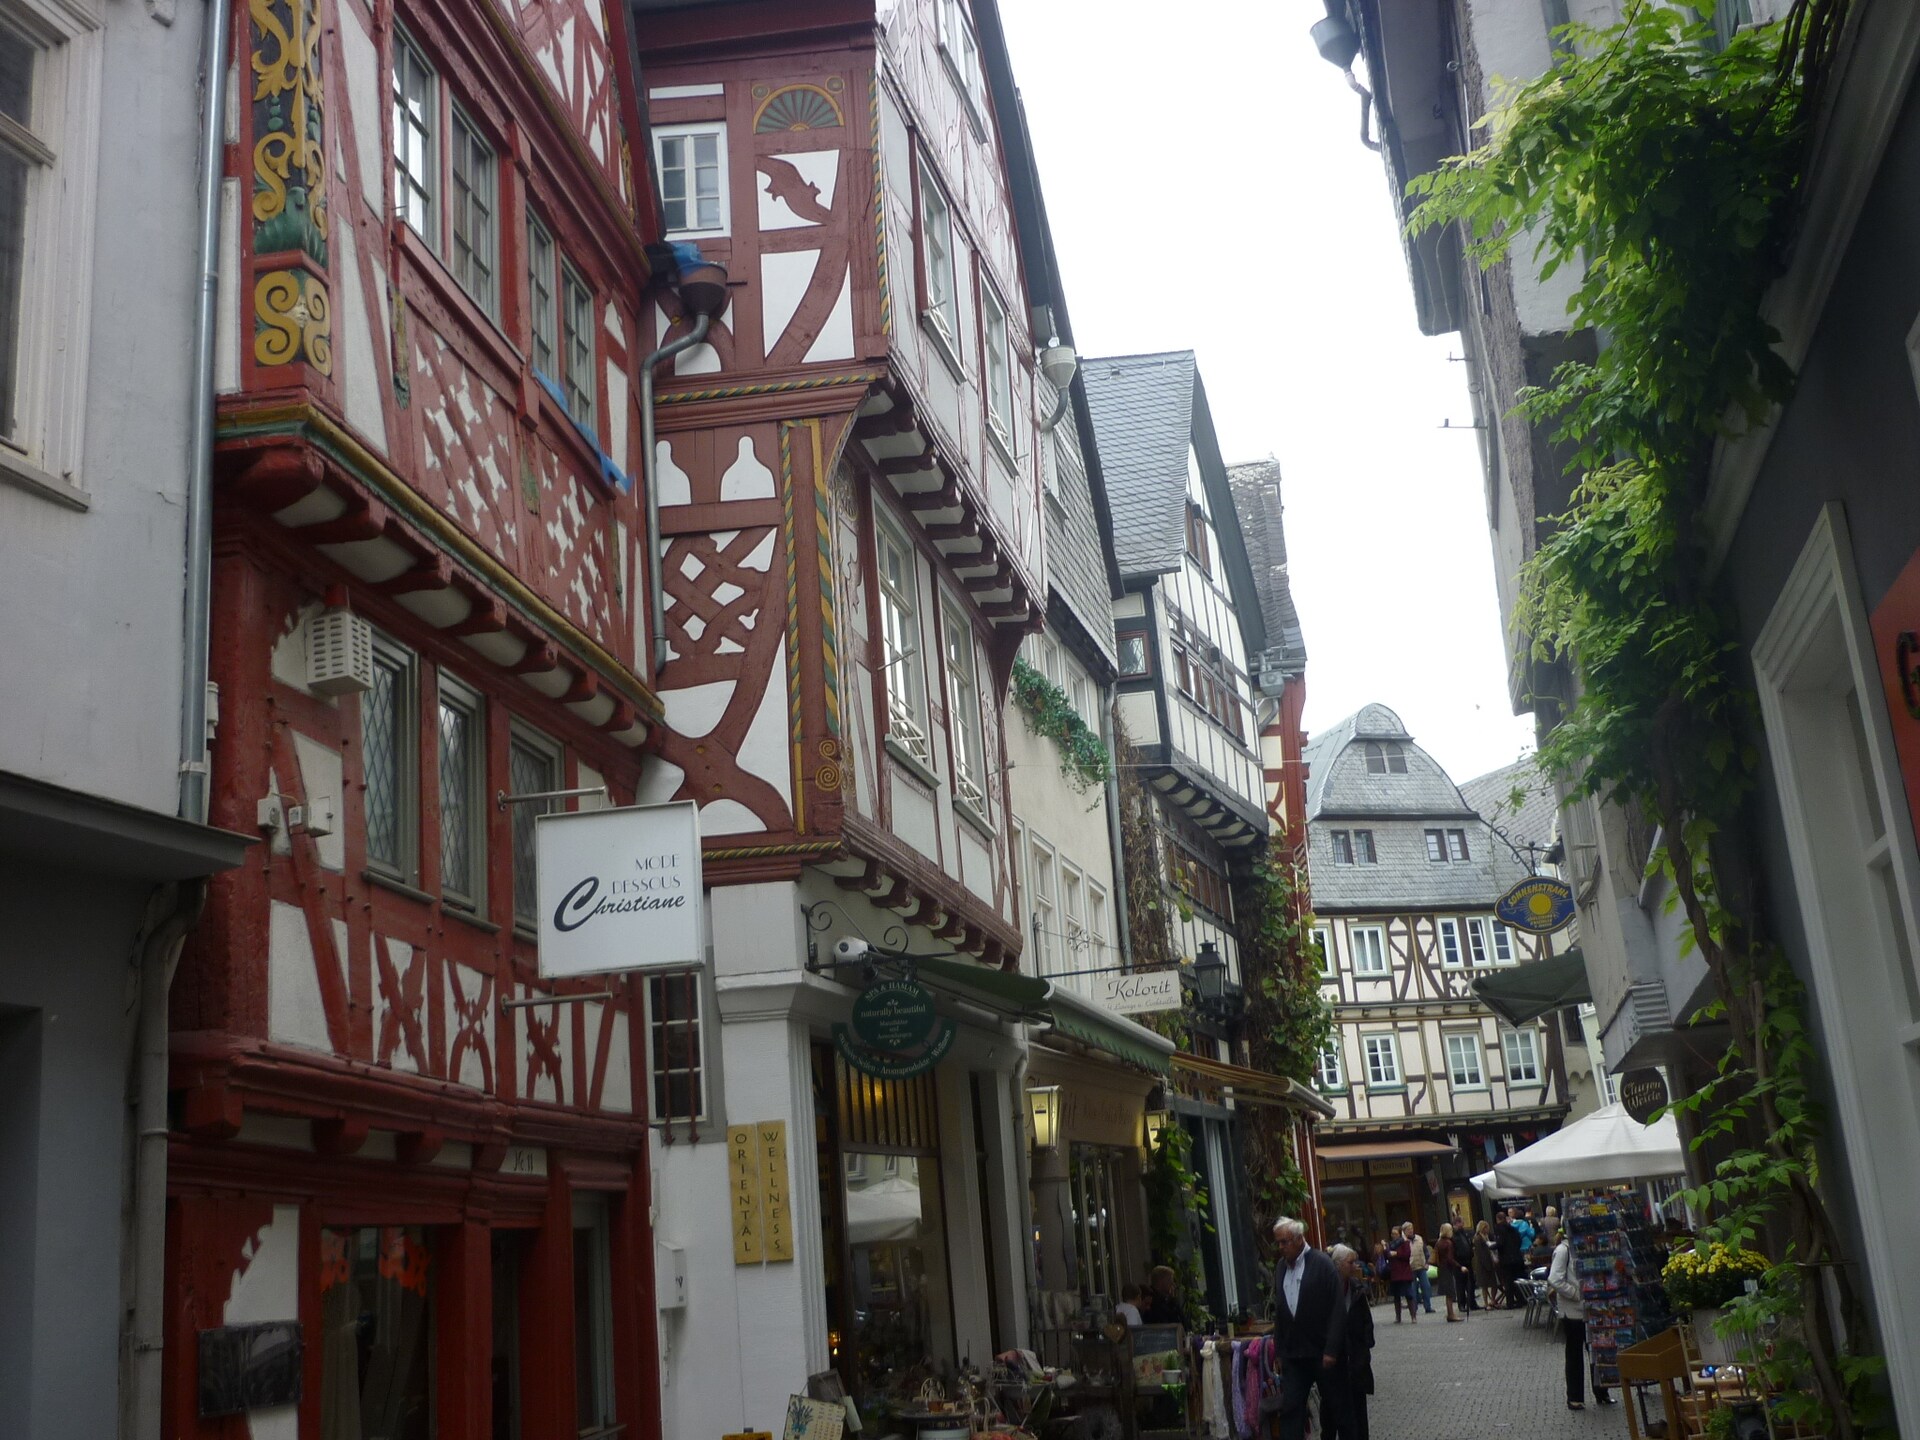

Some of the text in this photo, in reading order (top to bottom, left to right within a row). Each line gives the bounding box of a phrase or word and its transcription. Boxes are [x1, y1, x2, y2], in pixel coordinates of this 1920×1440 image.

[635, 854, 680, 871] MODE
[612, 874, 681, 894] DESSOUS
[1508, 883, 1569, 907] SONNENSTRAHL
[553, 876, 686, 932] Christiane
[865, 987, 880, 1000] SPA
[889, 982, 920, 998] HAMAM
[1106, 976, 1171, 1002] Kolorit
[861, 1004, 926, 1018] naturally beautiful
[734, 1132, 752, 1252] ORIENTAL
[762, 1131, 781, 1249] WELLNESS
